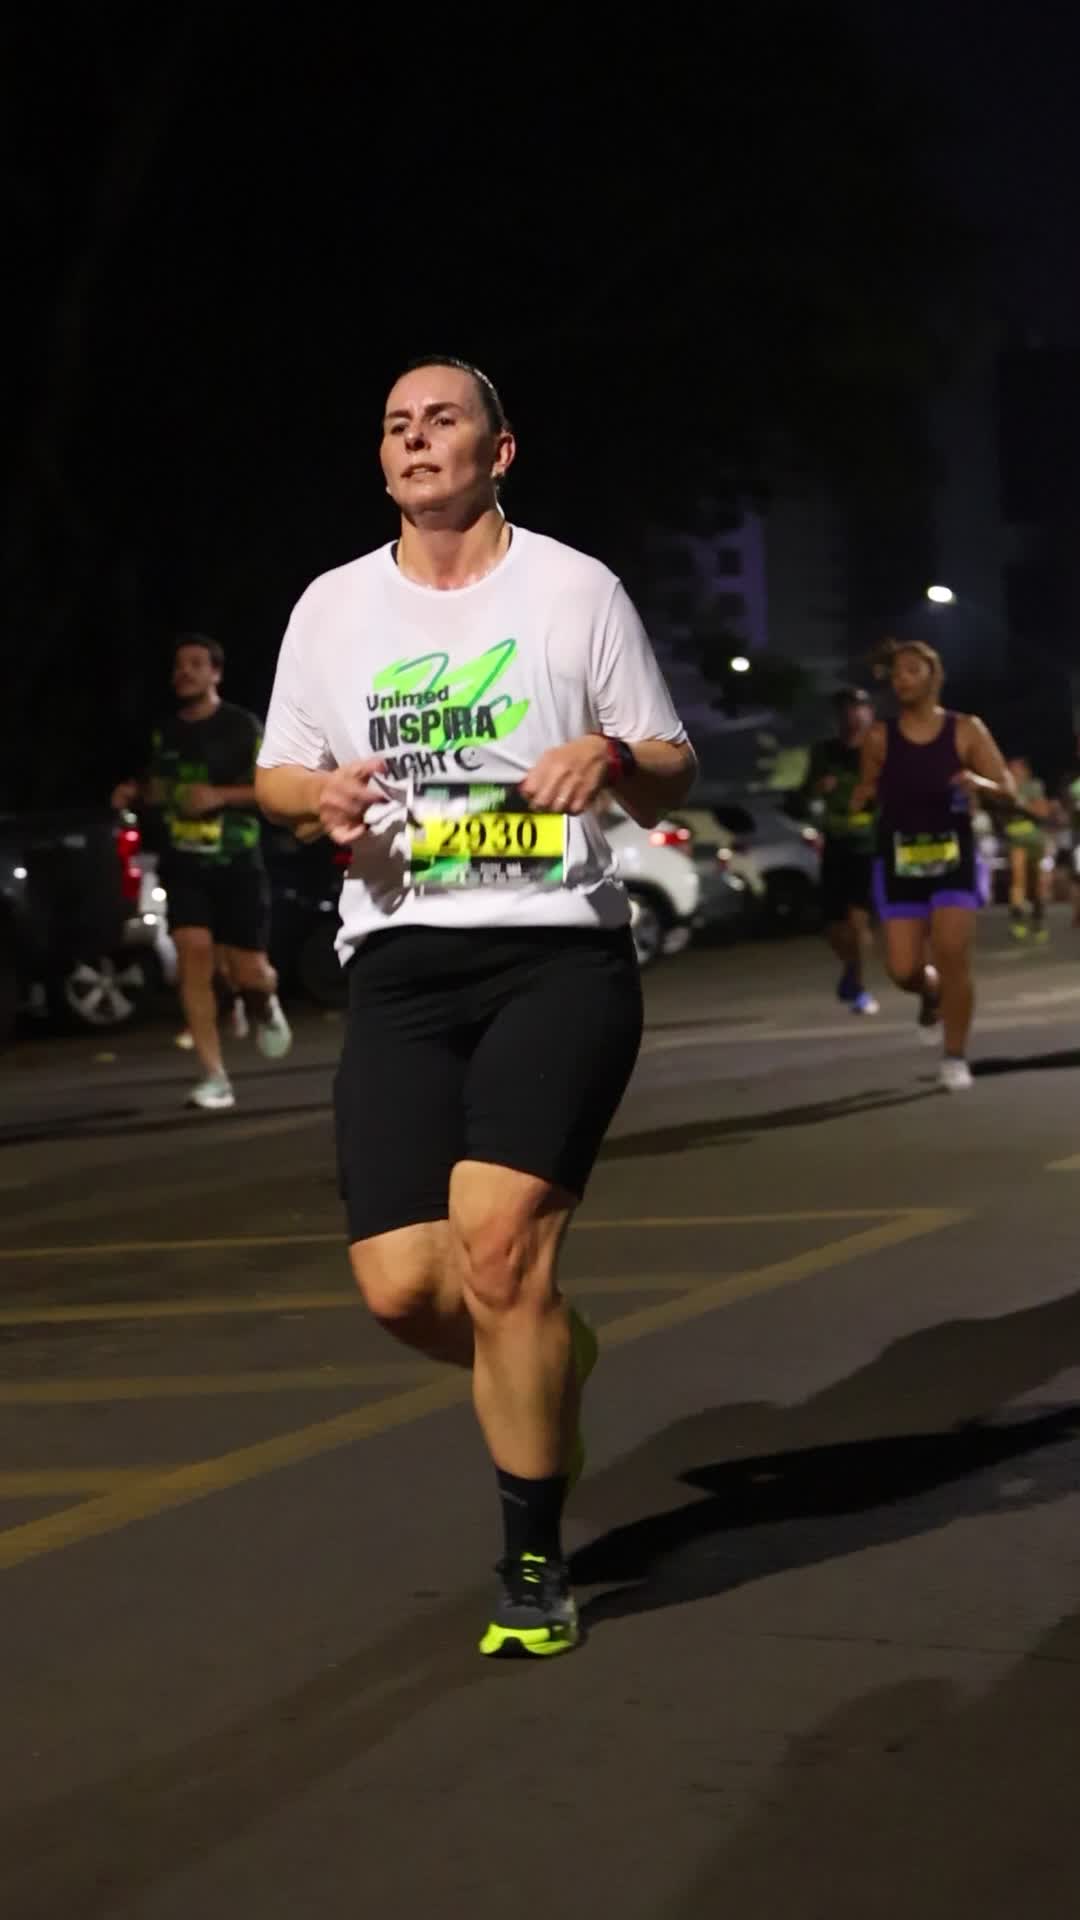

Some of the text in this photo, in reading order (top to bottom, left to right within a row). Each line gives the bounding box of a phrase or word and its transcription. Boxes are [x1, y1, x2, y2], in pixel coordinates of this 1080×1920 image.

[367, 687, 449, 711] Unimed
[369, 706, 497, 750] INSPIRA
[440, 816, 538, 855] 2930
